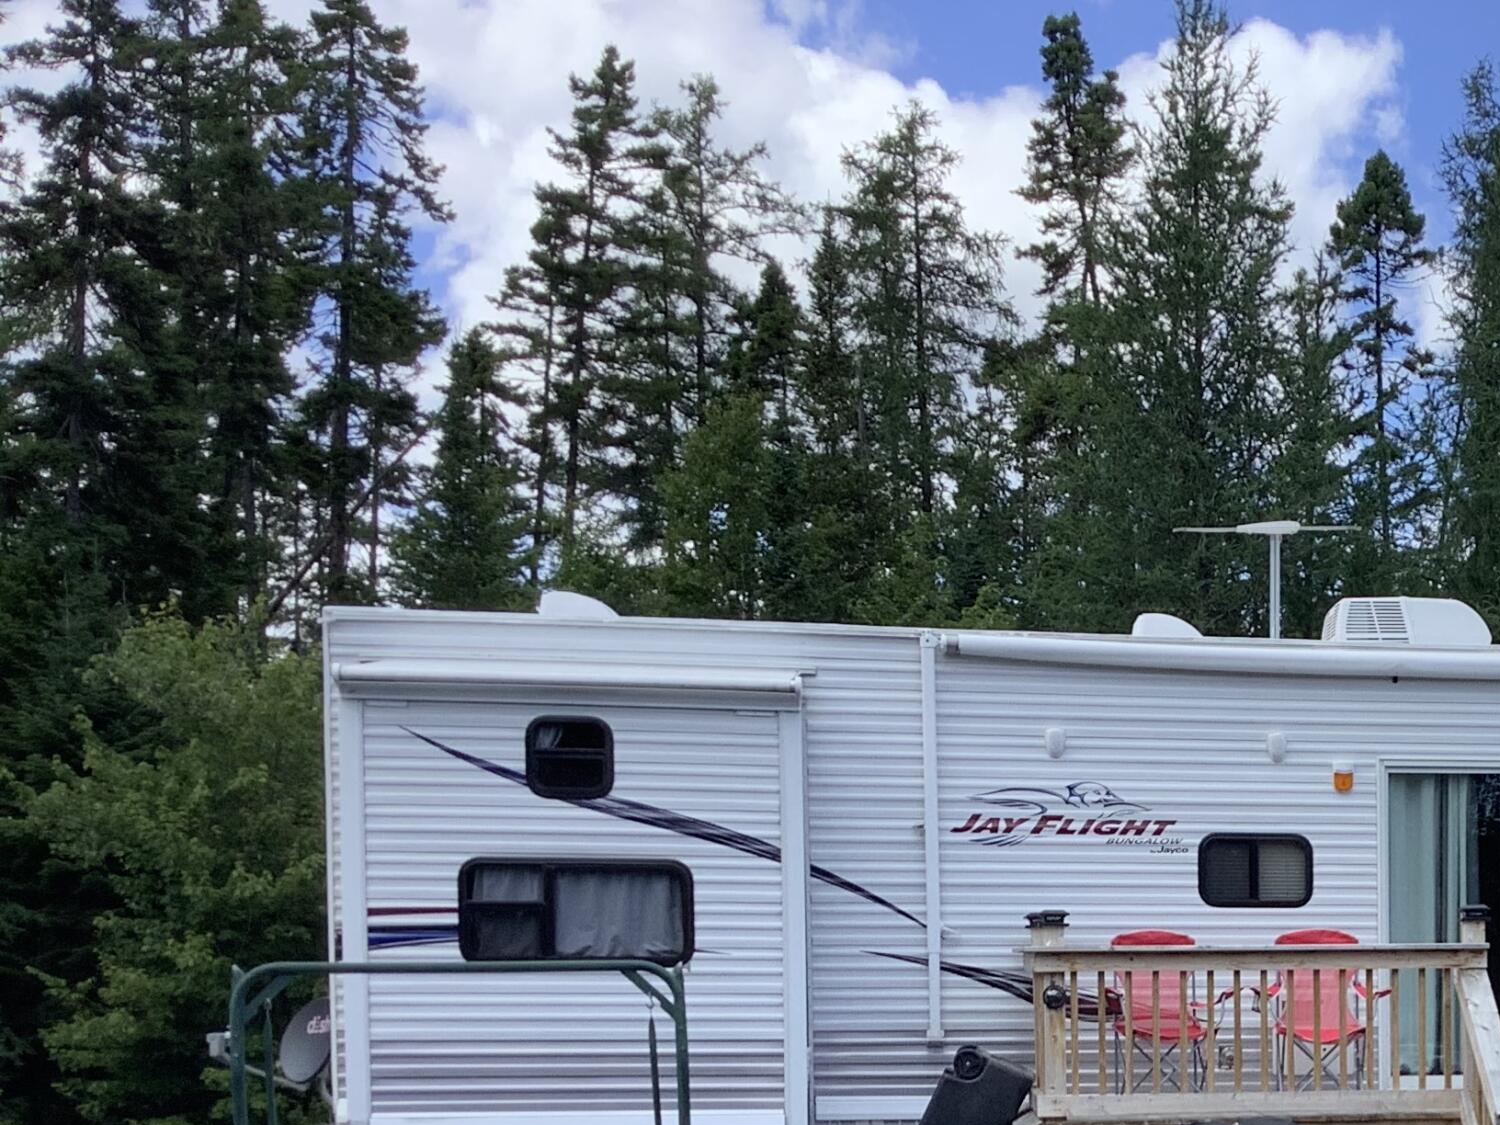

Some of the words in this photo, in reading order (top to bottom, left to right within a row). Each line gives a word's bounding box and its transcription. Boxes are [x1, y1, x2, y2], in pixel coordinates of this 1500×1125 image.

[1030, 814, 1178, 836] FLIGHT
[1105, 837, 1183, 845] BUNGALOW
[1157, 845, 1189, 854] Jayco
